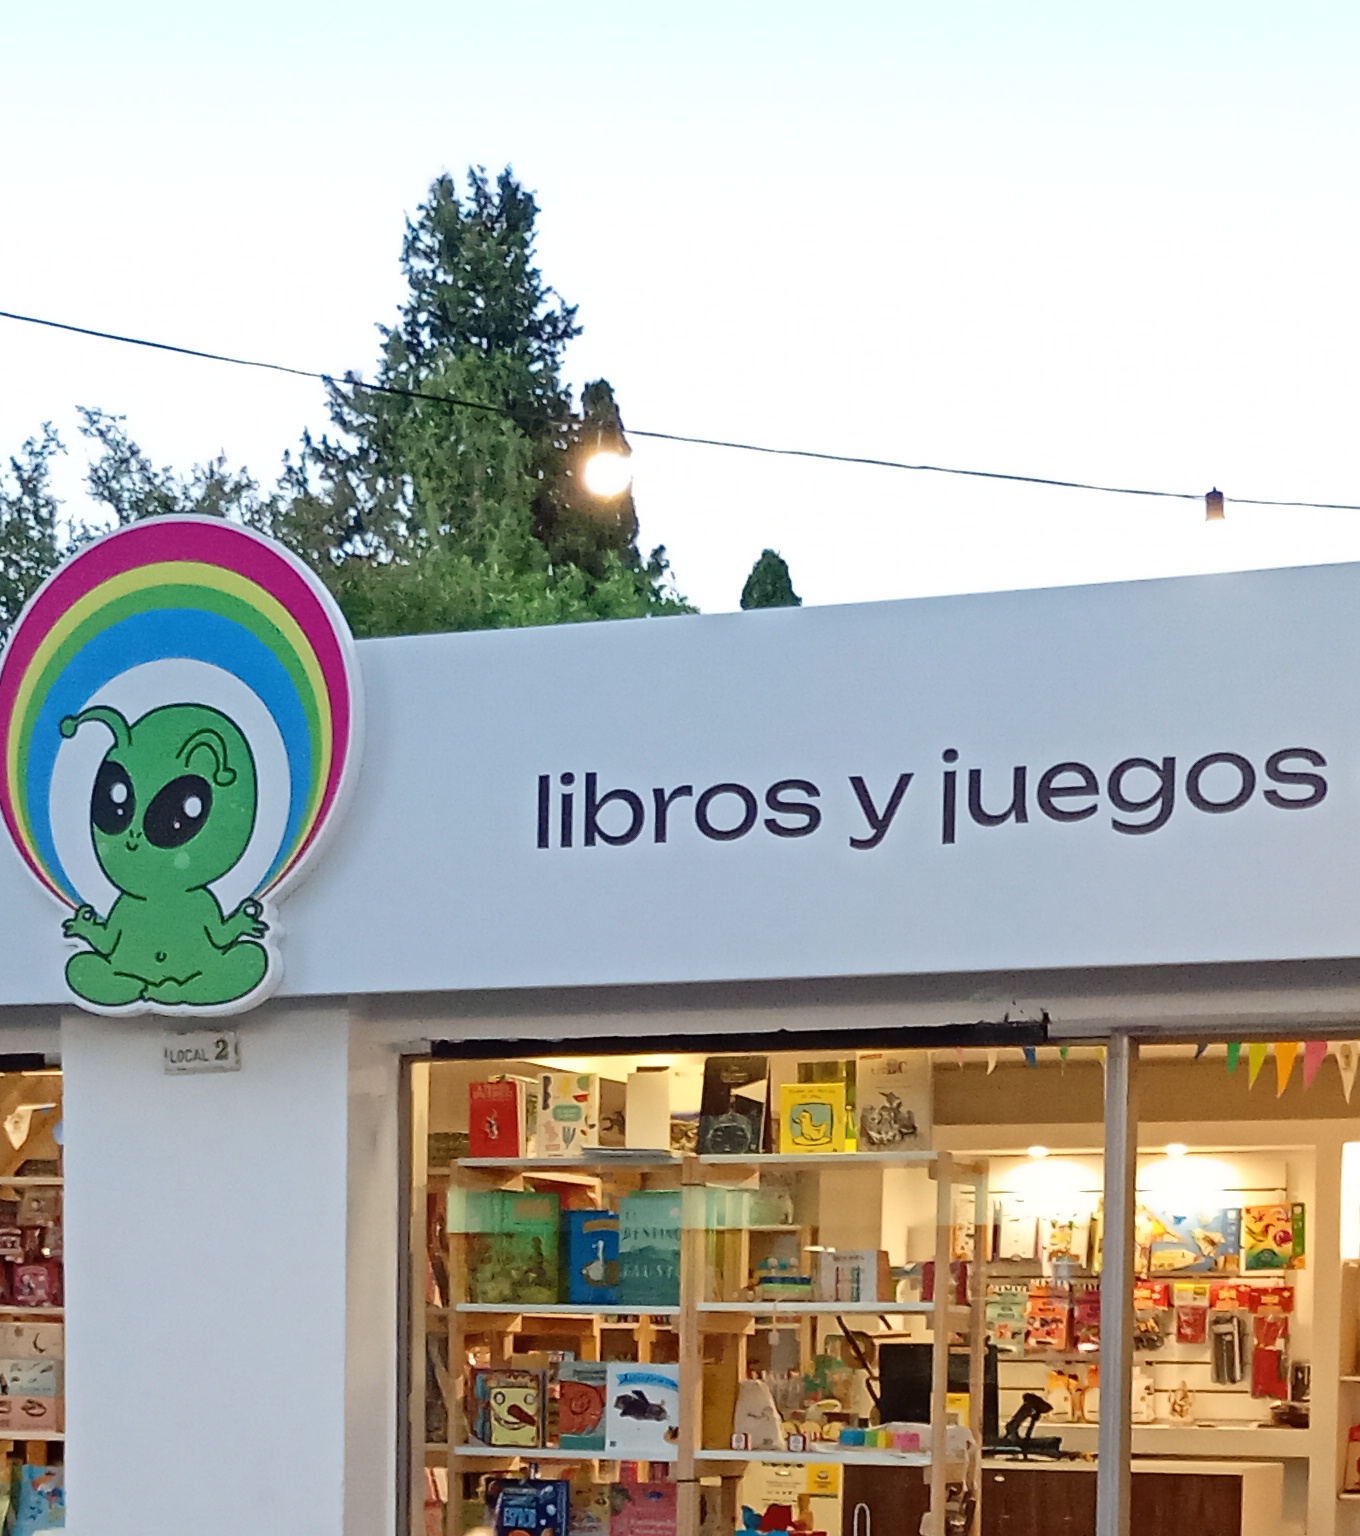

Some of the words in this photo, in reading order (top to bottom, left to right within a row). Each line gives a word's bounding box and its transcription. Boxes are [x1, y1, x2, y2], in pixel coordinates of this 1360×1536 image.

[536, 771, 822, 850] libros
[847, 772, 915, 851] y
[941, 747, 1328, 845] juegos
[169, 1048, 210, 1064] LOCAL
[214, 1038, 230, 1062] 2
